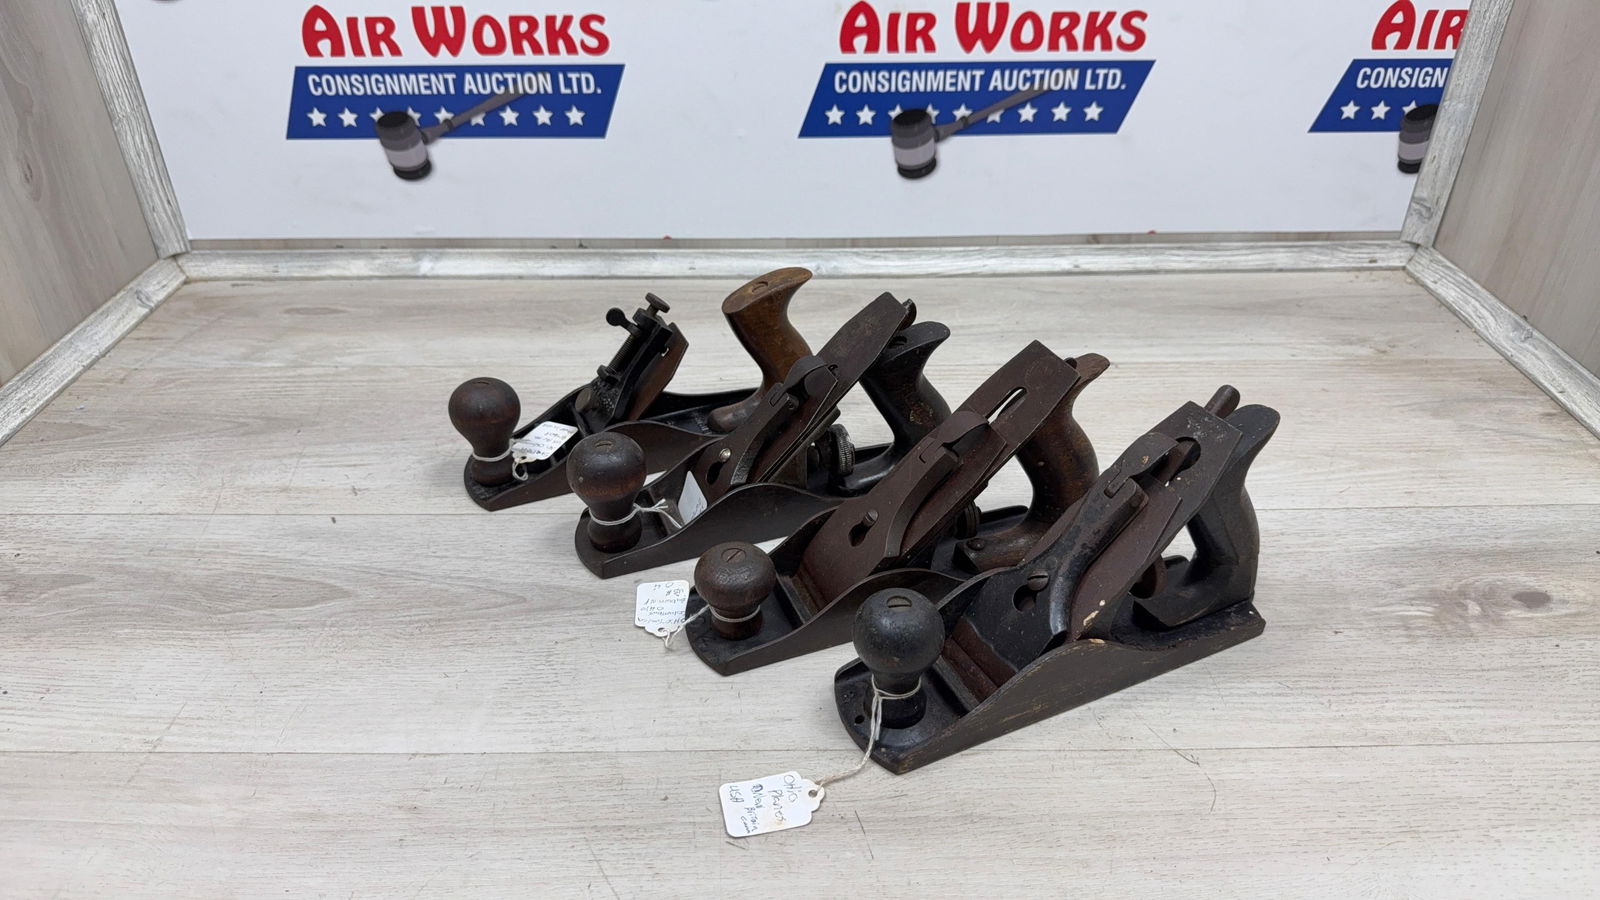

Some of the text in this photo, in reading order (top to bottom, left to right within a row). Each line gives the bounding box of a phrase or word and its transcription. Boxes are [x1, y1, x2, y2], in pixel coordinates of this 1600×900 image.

[302, 4, 610, 57] AIR WORKS
[839, 0, 1148, 54] AIR WORKS
[1371, 0, 1470, 50] AIR
[307, 71, 602, 96] CONSIGNMENT AUCTION LTD.
[834, 68, 1127, 93] CONSIGNMENT AUCTION LTD.
[1356, 67, 1449, 88] CONSIGN
